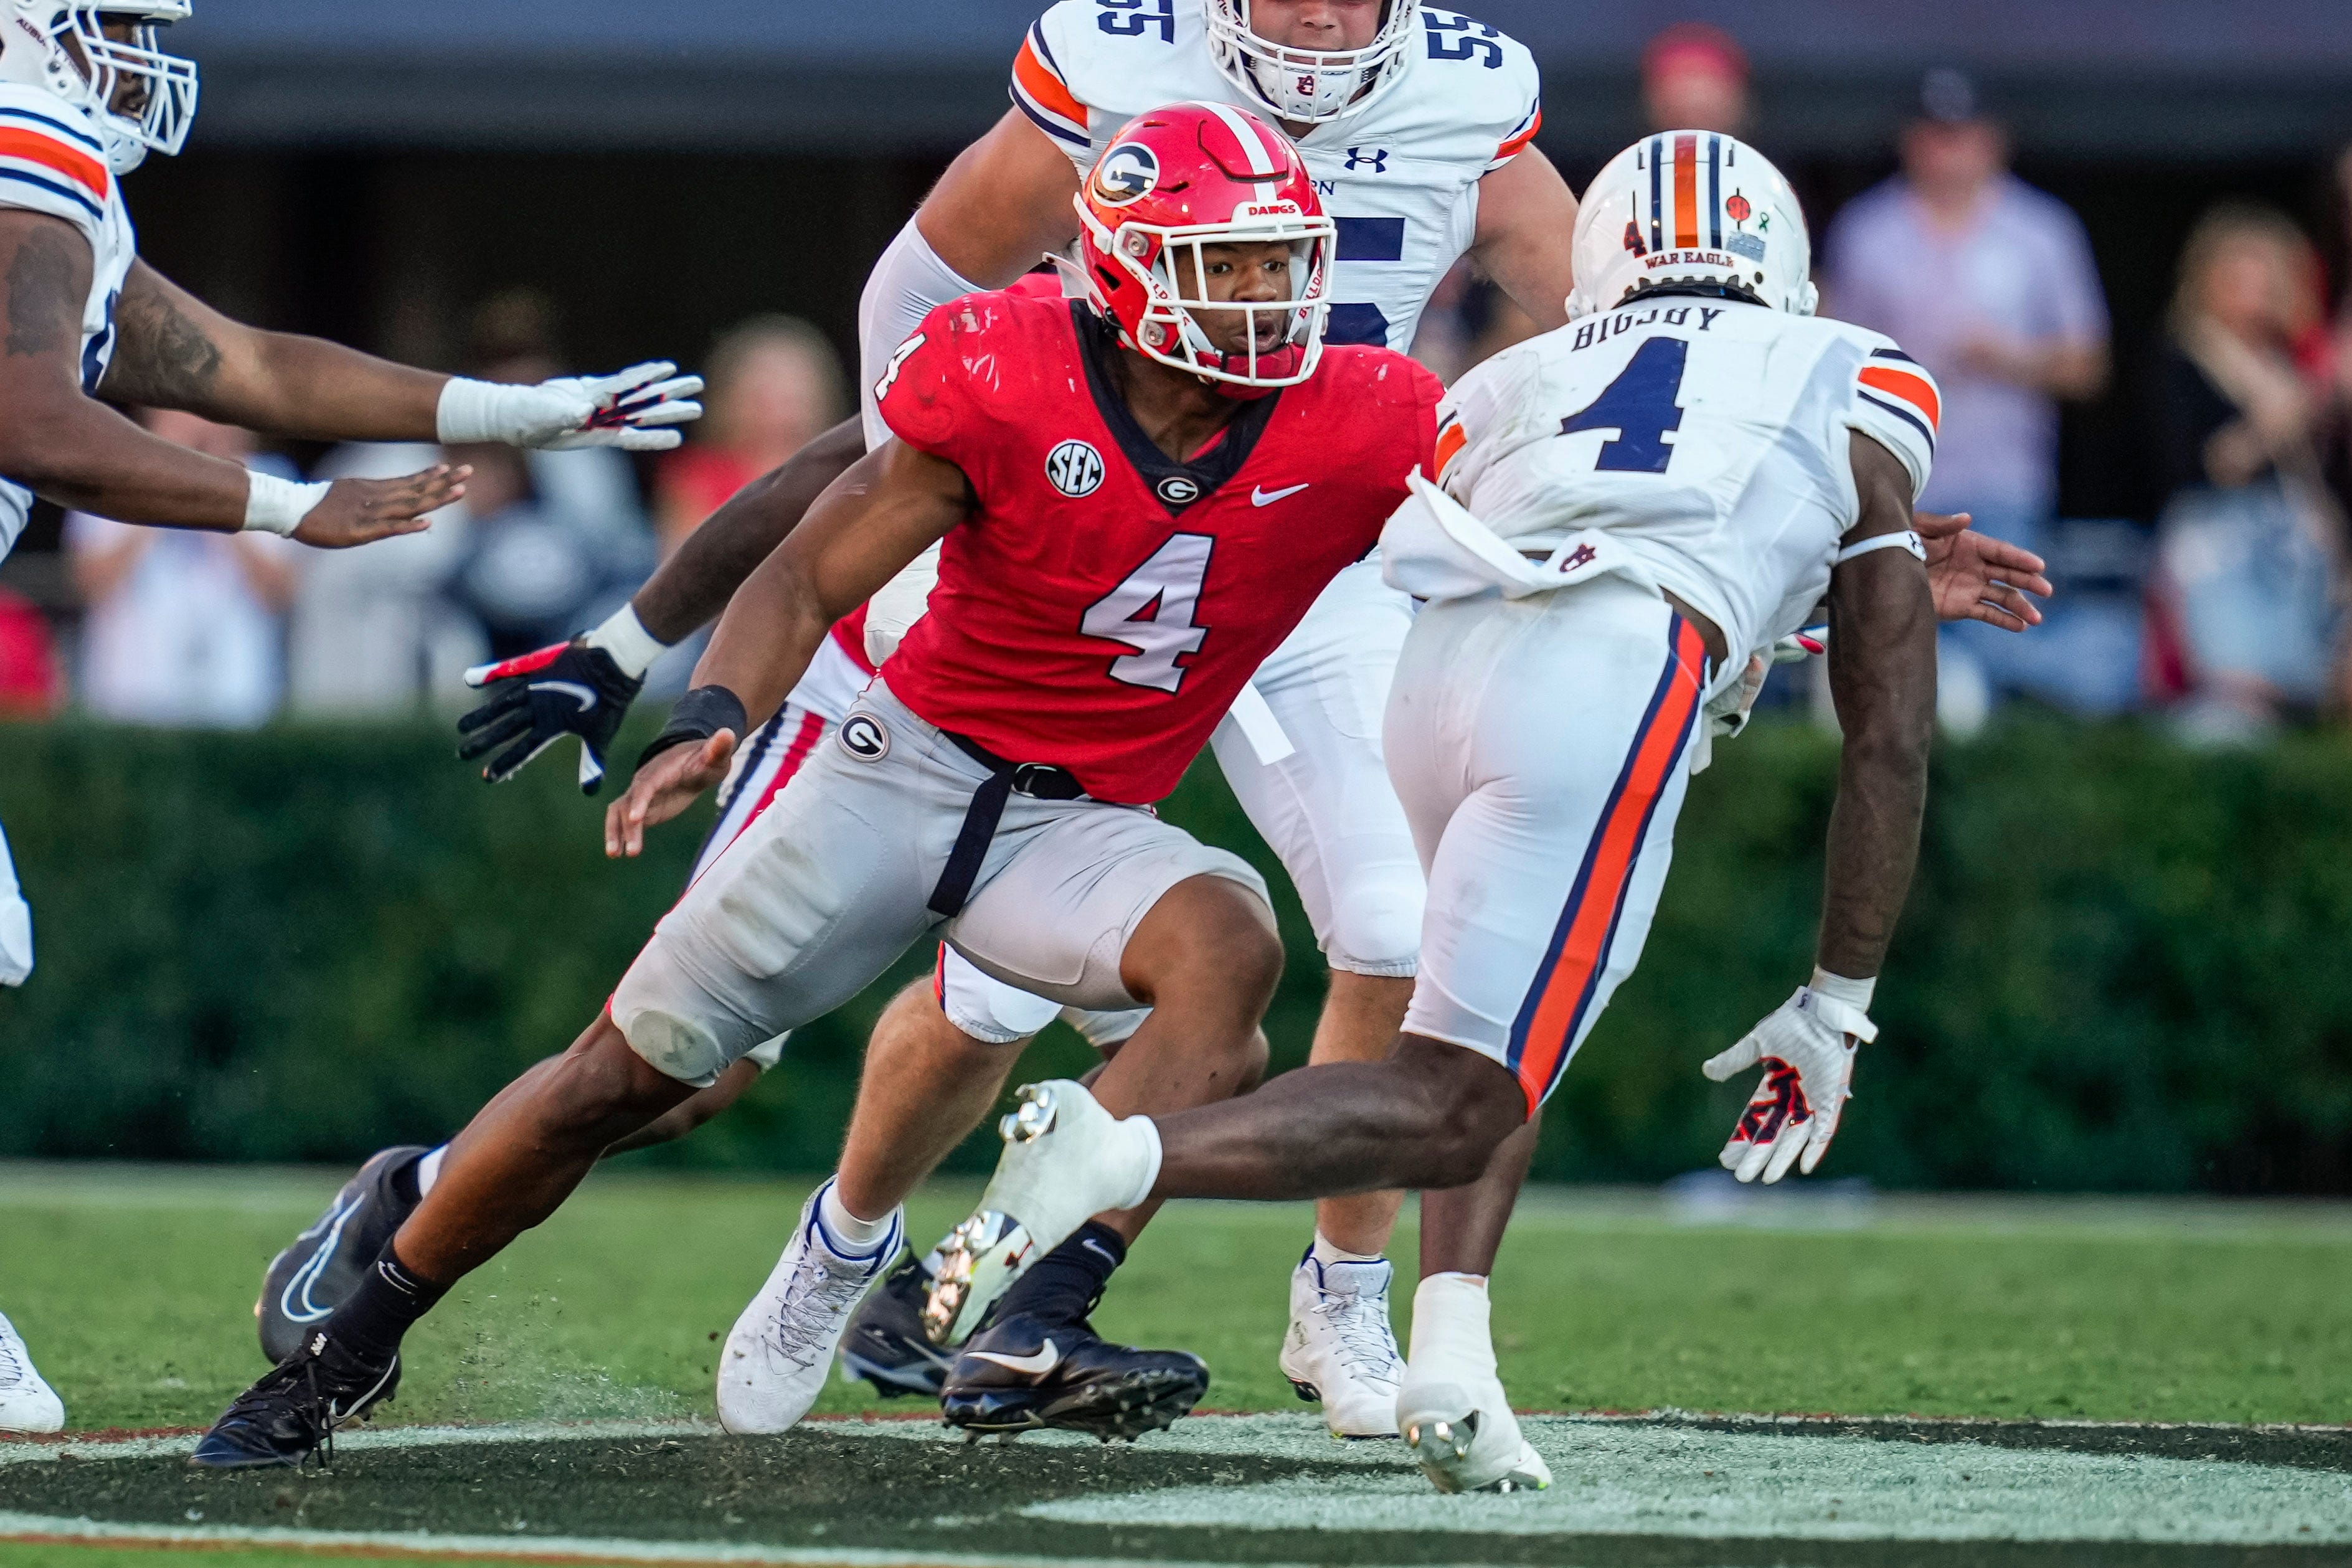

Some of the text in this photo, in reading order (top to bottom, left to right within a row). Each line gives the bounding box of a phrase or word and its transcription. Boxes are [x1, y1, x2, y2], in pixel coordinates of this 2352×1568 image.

[1249, 205, 1296, 215] DAWGS
[1645, 252, 1735, 270] WAR EAGLE
[874, 331, 927, 402] 4
[1556, 337, 1689, 474] 4
[1050, 443, 1102, 494] SEC
[1079, 532, 1216, 696] 4
